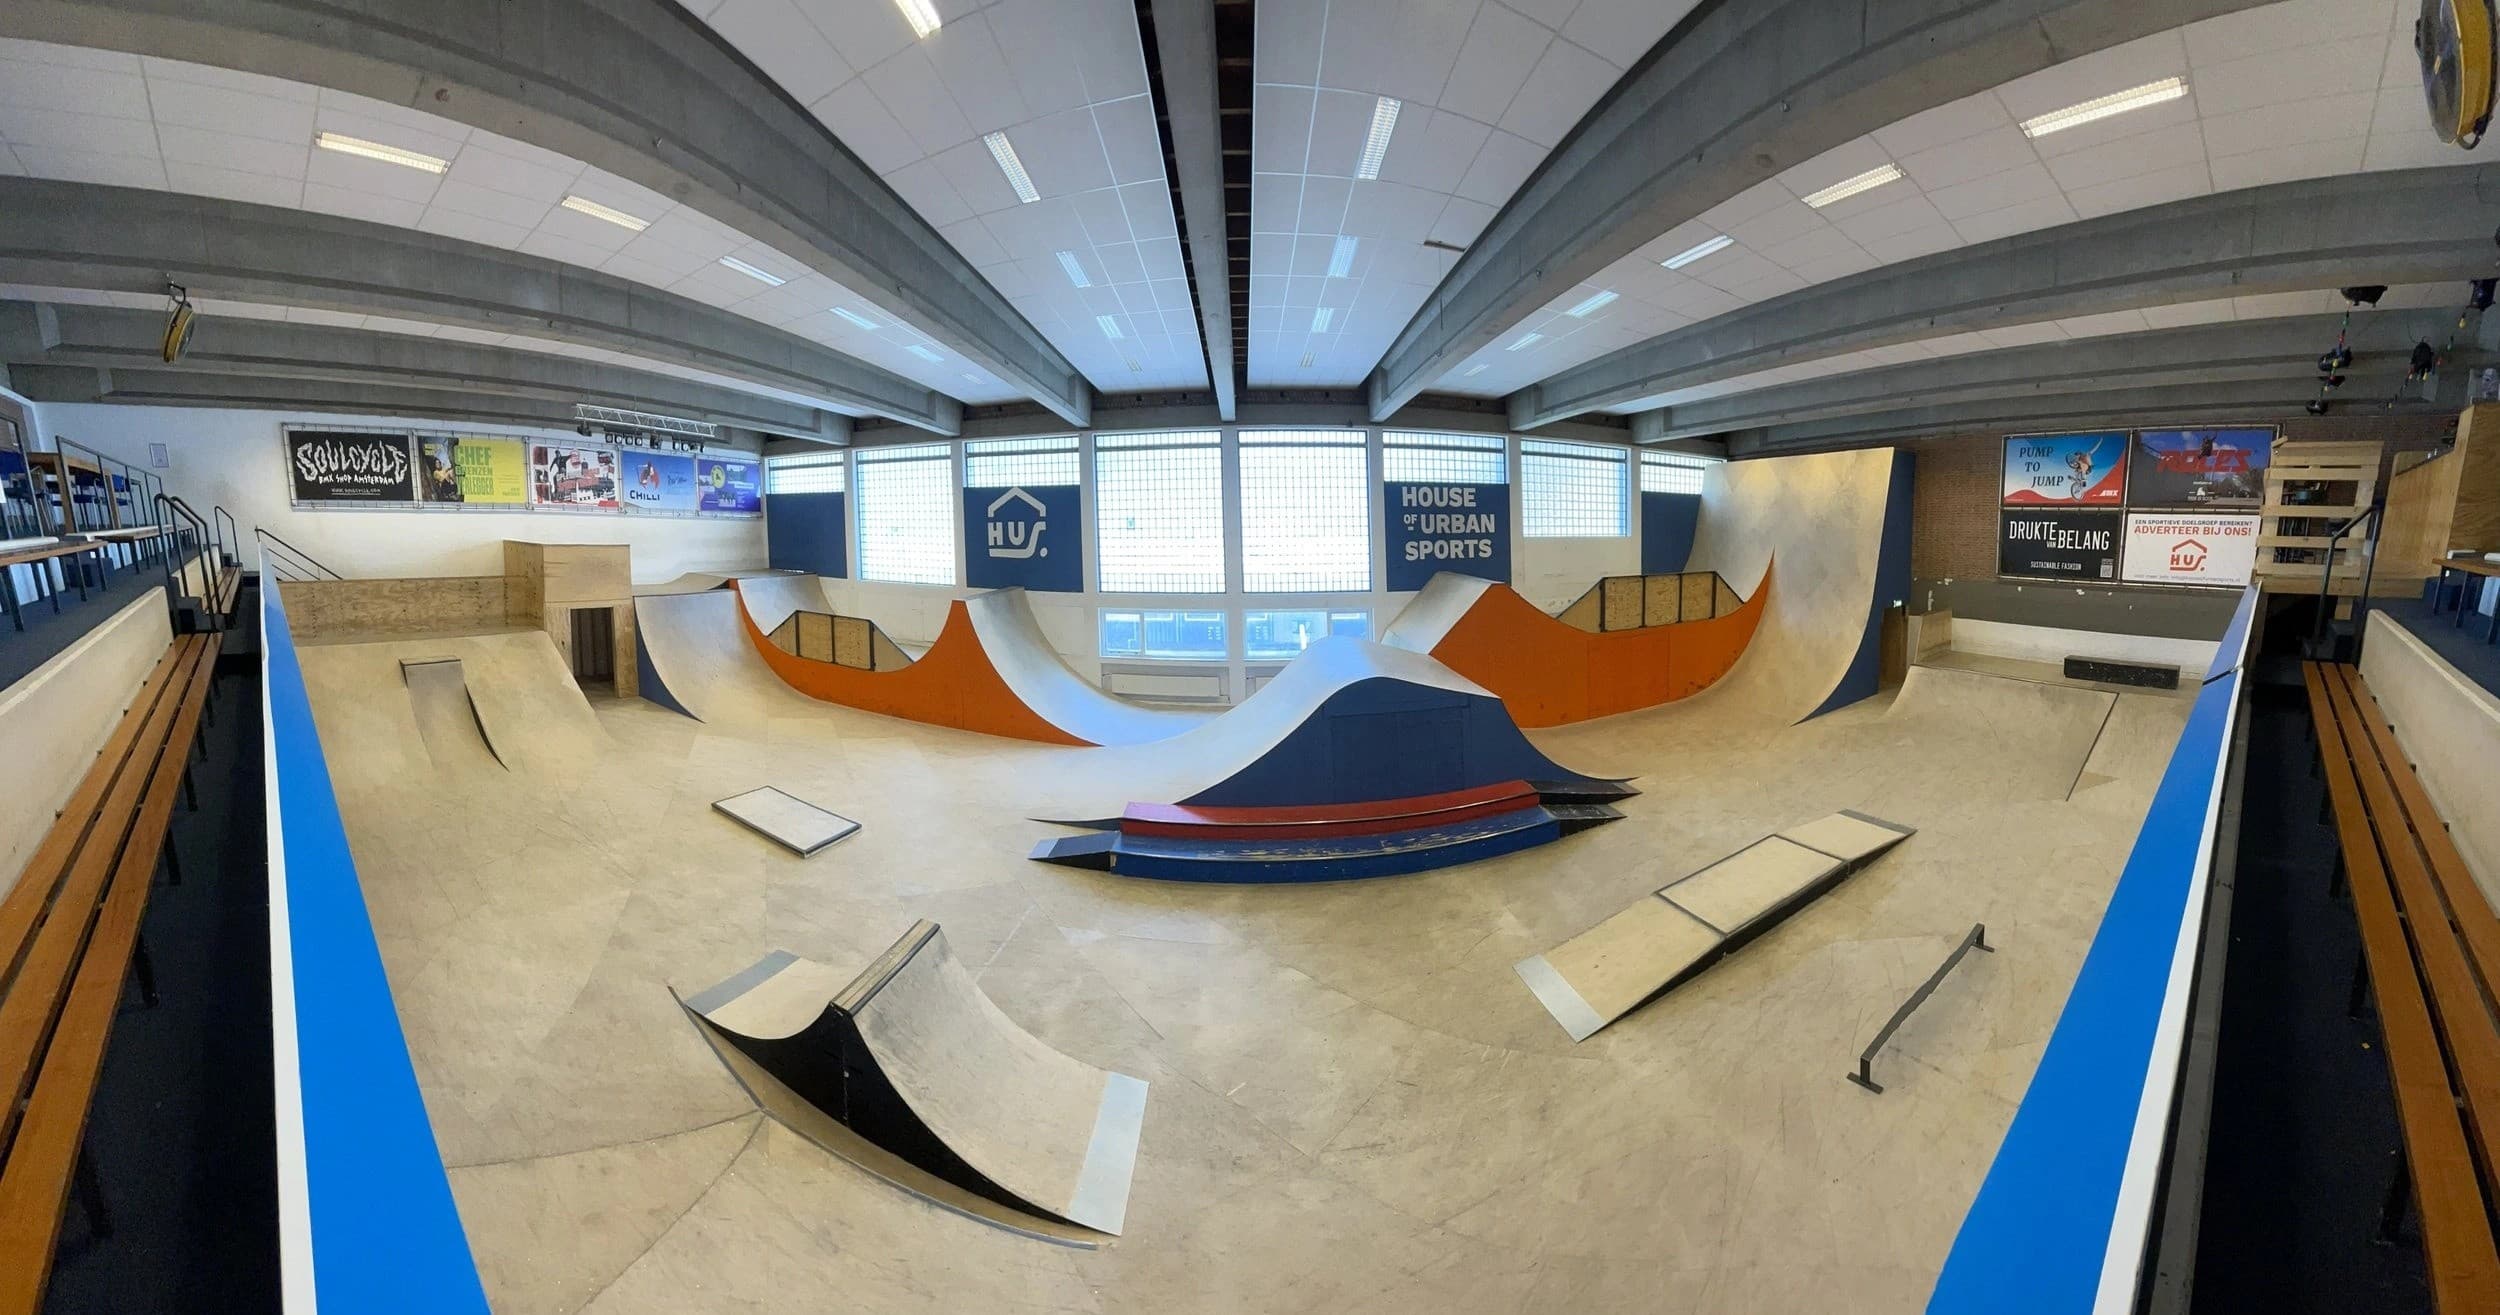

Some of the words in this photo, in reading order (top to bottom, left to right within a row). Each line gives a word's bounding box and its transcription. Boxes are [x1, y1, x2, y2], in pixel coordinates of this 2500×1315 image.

[454, 445, 492, 466] CHEF
[2019, 447, 2054, 458] PUMP
[296, 439, 407, 484] SOULCYCLE
[2024, 461, 2041, 472] TO
[318, 473, 334, 485] BMX
[335, 473, 352, 484] SHOP
[353, 473, 396, 485] AMSTERDAM
[2031, 475, 2064, 489] JUMP
[629, 489, 661, 501] CHILLI
[1401, 486, 1477, 508] HOUSE
[1403, 514, 1418, 525] OF
[1420, 513, 1496, 534] URBAN
[2009, 520, 2058, 541] DRUKTE
[2134, 525, 2200, 536] ADVERTEER
[2202, 526, 2221, 536] BIJ
[2224, 526, 2252, 536] ONS!
[2046, 541, 2057, 549] VAN
[2057, 529, 2110, 551] BELANG
[1405, 538, 1492, 561] SPORTS
[2030, 560, 2061, 570] SUSTAINABLE
[2061, 562, 2082, 571] FASHION
